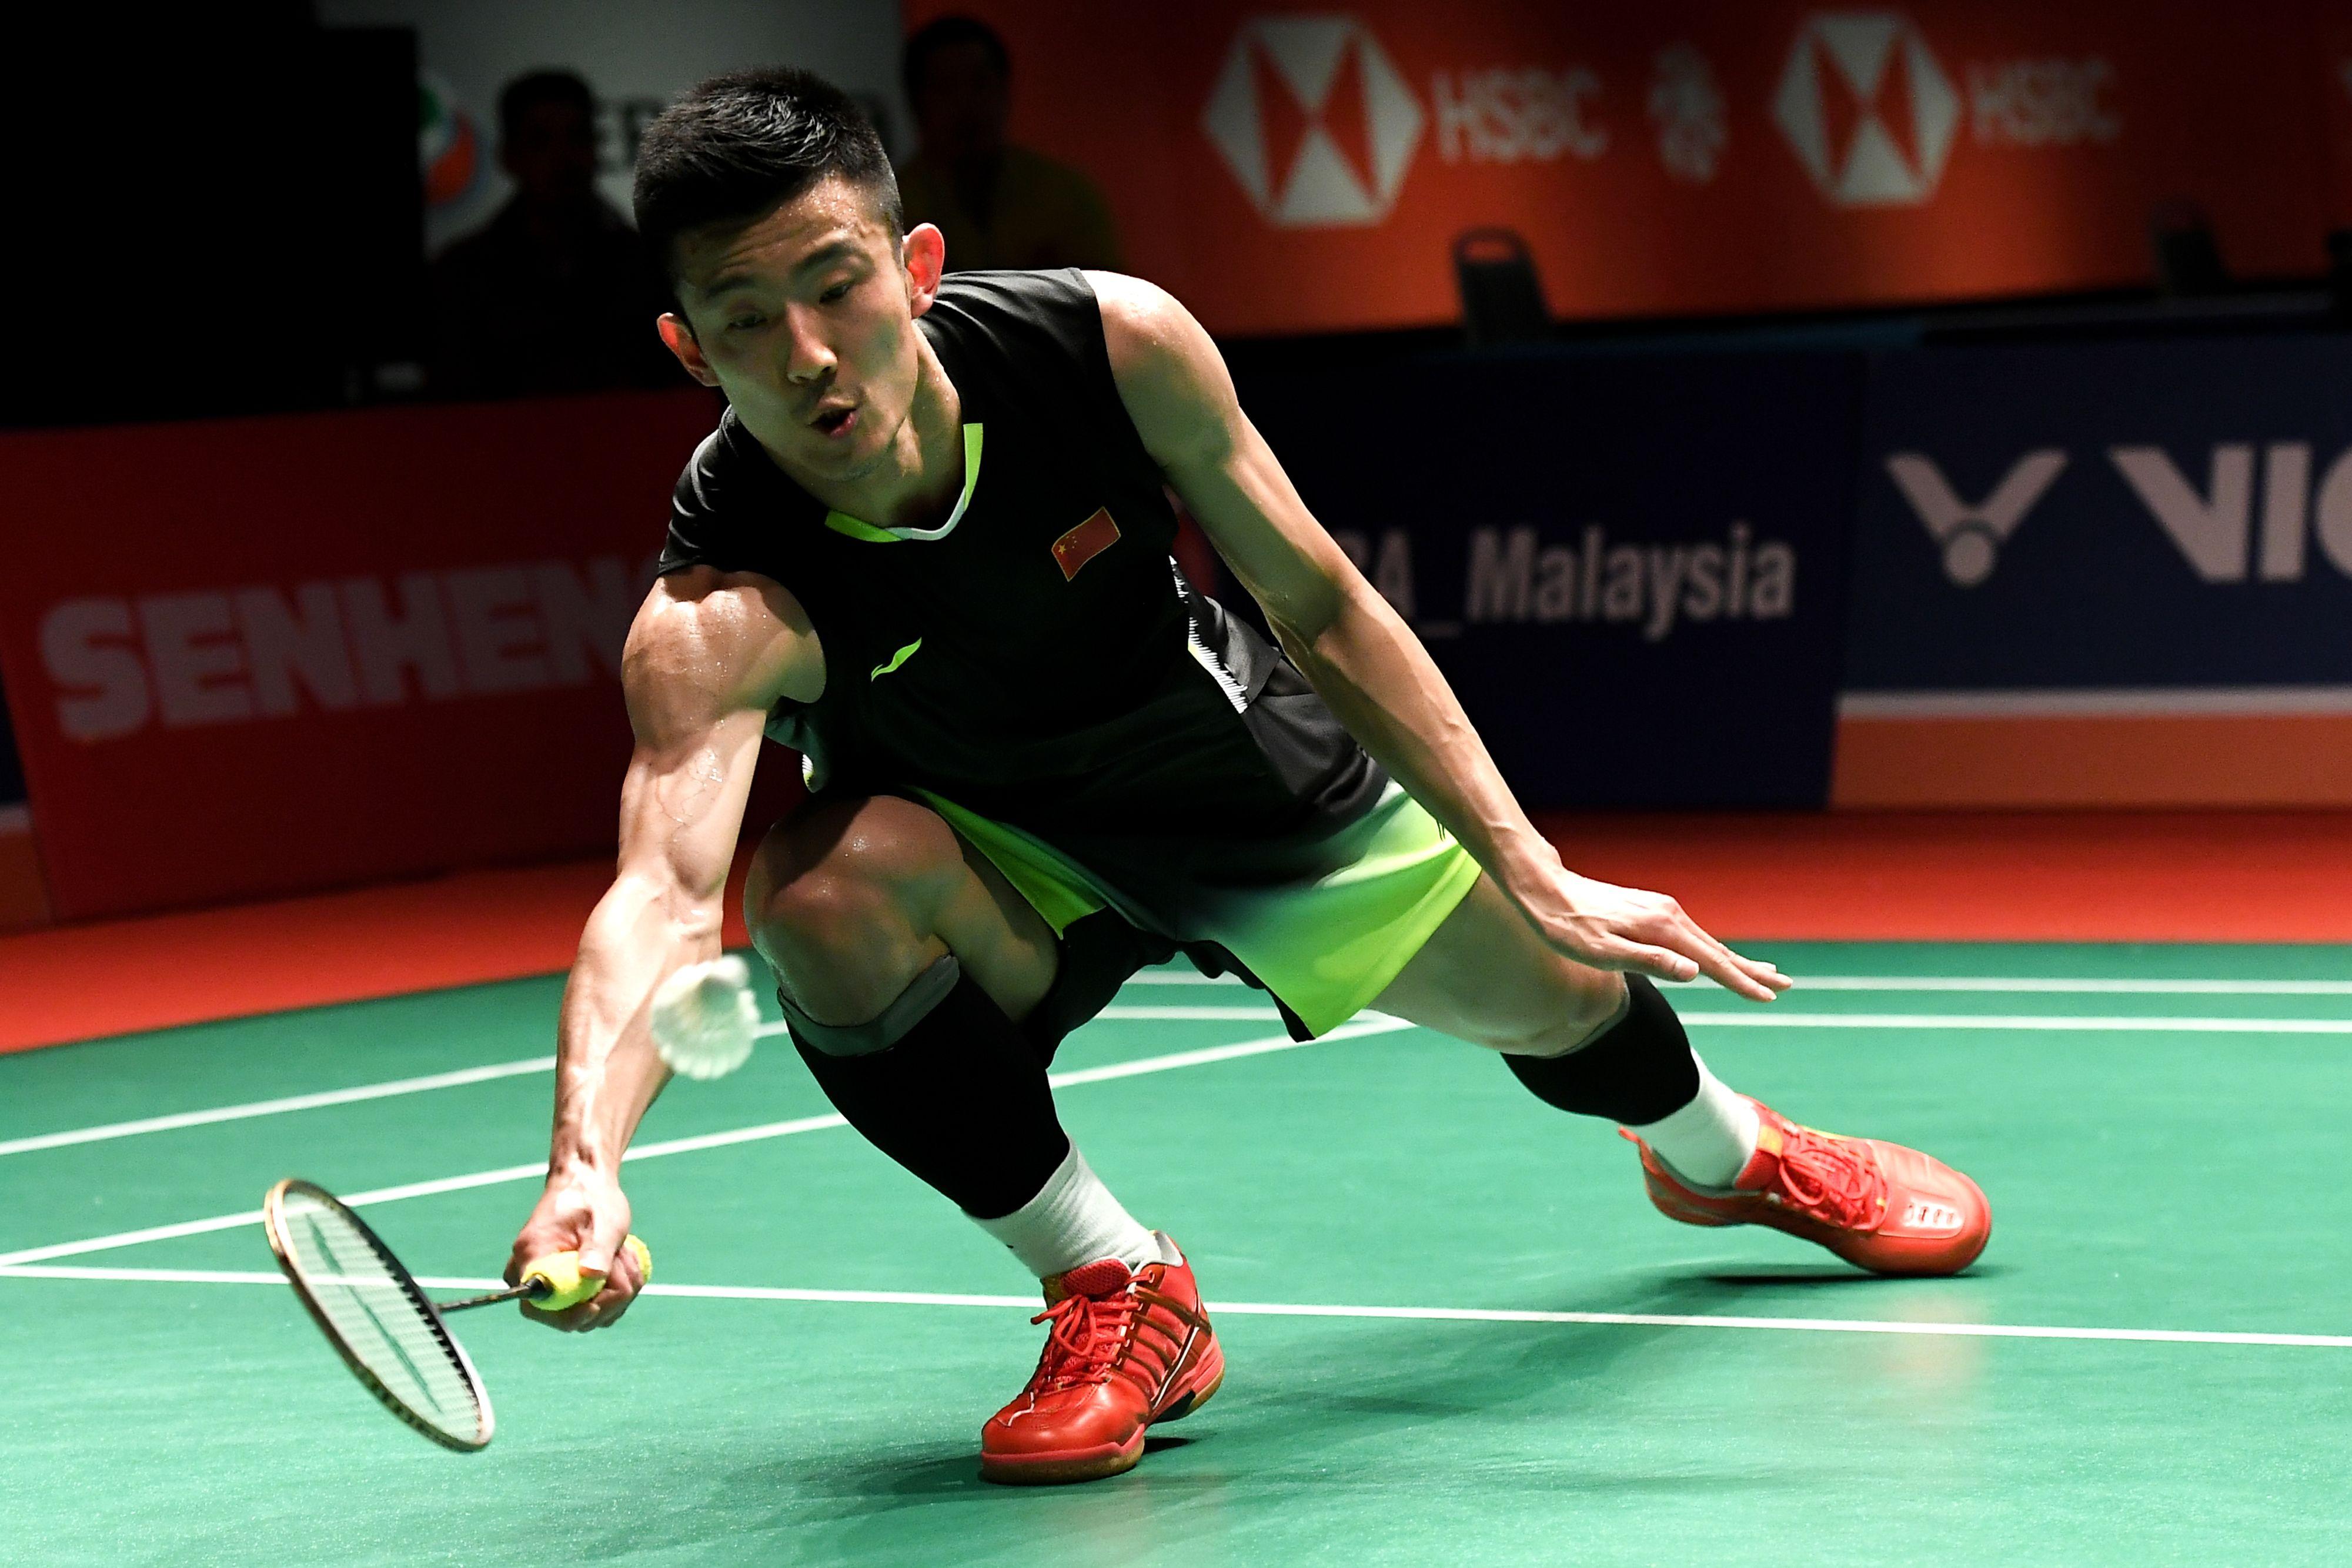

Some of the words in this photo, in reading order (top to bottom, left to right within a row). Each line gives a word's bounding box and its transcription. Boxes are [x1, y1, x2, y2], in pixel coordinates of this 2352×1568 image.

[1431, 65, 1609, 165] HSBC
[1970, 56, 2123, 147] HSBC
[39, 555, 659, 743] SENHEN
